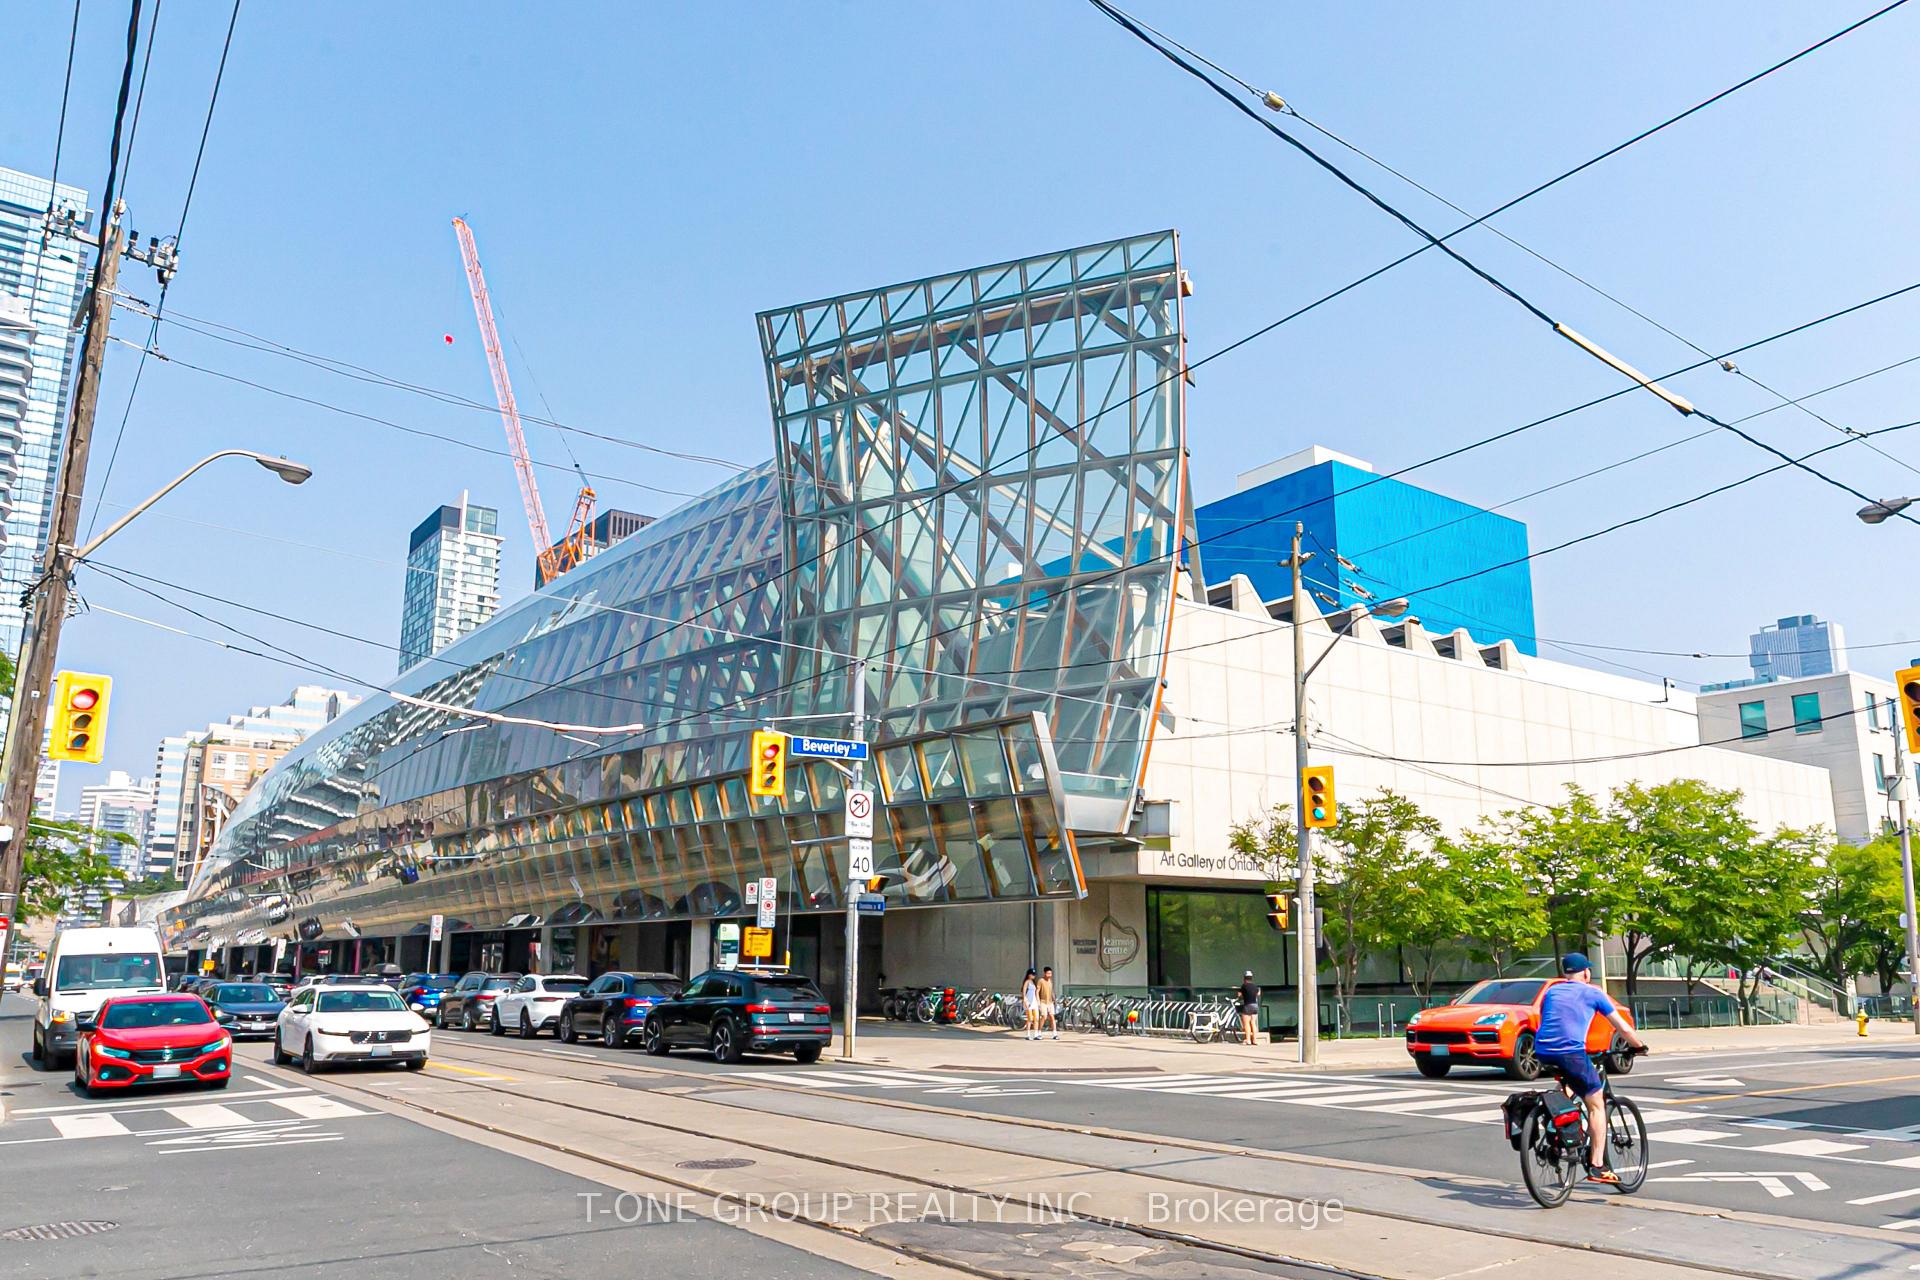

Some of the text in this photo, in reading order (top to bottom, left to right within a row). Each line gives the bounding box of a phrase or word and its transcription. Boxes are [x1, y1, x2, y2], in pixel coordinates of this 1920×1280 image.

[802, 739, 850, 757] Beverley
[852, 857, 869, 872] 40
[1160, 851, 1175, 866] Art
[1177, 853, 1214, 872] Gallery
[1216, 856, 1226, 870] of
